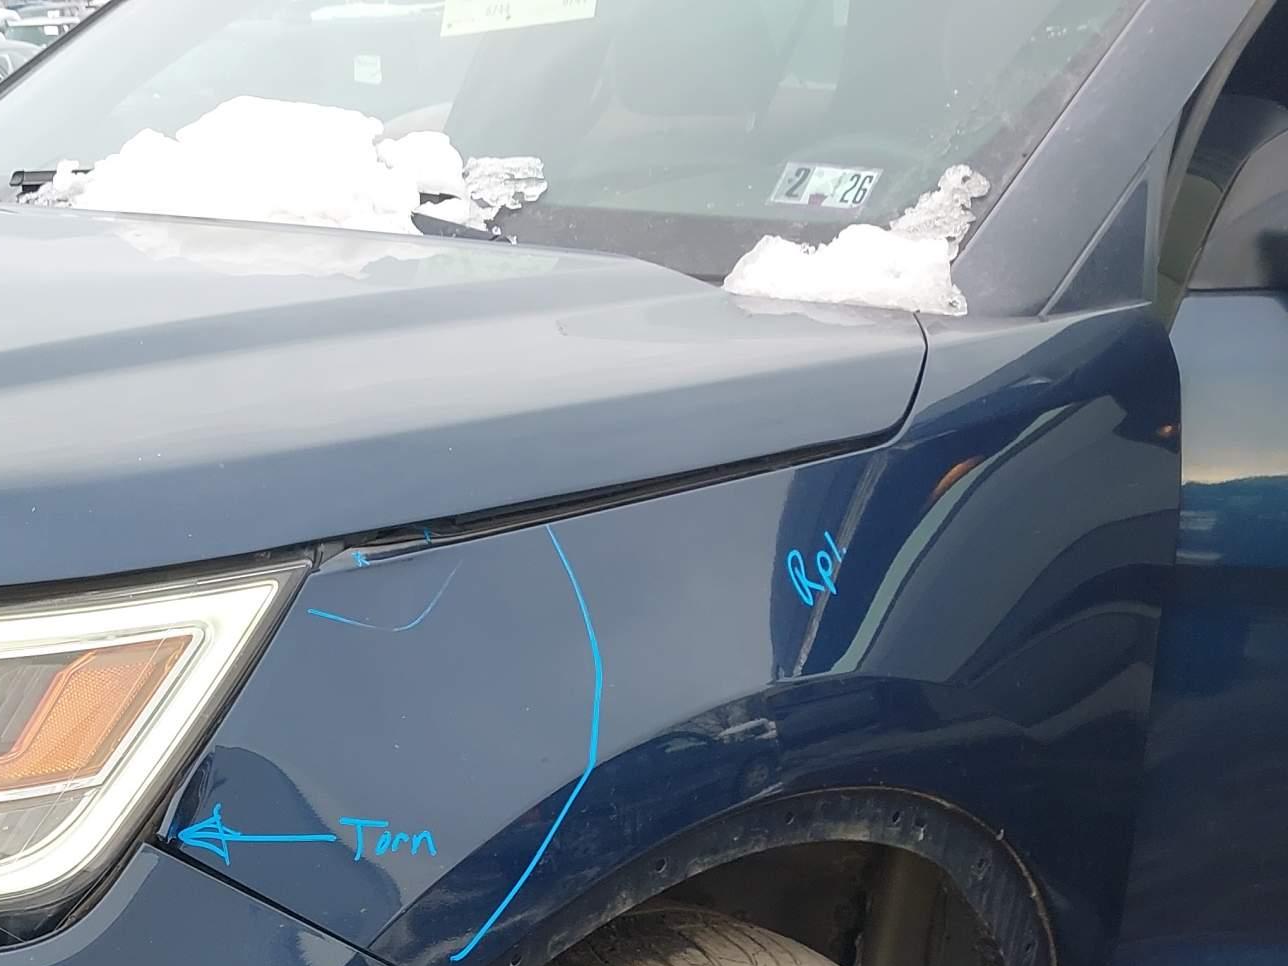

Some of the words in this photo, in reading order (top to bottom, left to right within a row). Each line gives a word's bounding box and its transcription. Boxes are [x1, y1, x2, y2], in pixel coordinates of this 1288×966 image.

[785, 167, 810, 197] 2
[840, 173, 873, 203] 26
[339, 816, 437, 861] Torn
